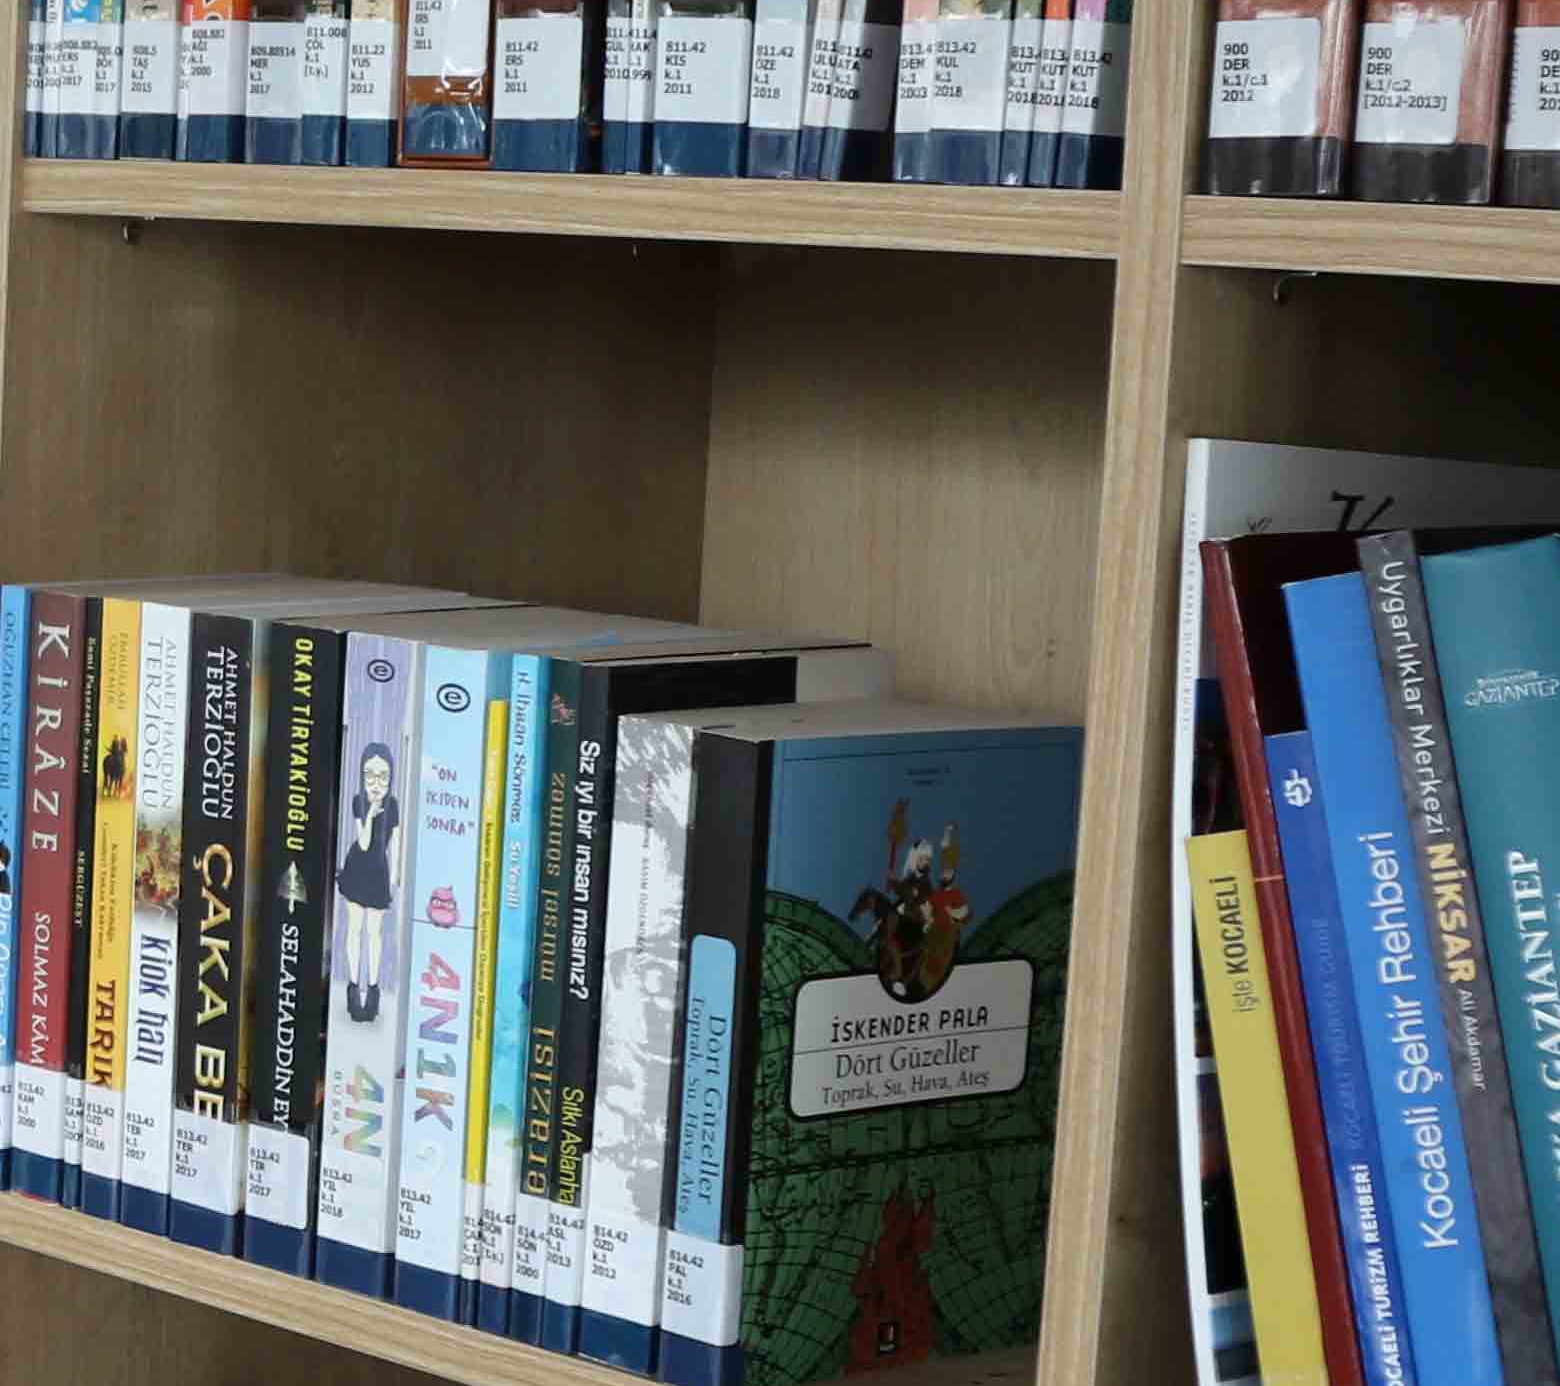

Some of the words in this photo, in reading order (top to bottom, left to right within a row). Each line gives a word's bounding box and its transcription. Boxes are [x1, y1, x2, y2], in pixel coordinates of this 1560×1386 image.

[506, 43, 539, 52] 811.42
[506, 56, 524, 66] ERS
[666, 42, 706, 54] 811.42
[666, 56, 686, 67] KIS
[937, 42, 976, 55] 813.42
[937, 56, 960, 68] KUL
[1223, 59, 1250, 71] DER
[1224, 43, 1248, 55] 900
[1366, 63, 1392, 75] DER
[1368, 47, 1392, 59] 900
[505, 82, 528, 93] 2011
[664, 84, 692, 94] 2011
[934, 86, 962, 98] 2018
[1222, 90, 1254, 102] 2012
[1381, 559, 1424, 716] Uygarlıklar
[294, 637, 314, 695] OKAY
[30, 619, 71, 854] KİRÂZE
[201, 645, 225, 820] TERZİOĞLU
[286, 703, 313, 851] TİRYAKİOĞLU
[1410, 722, 1452, 836] Merkezi
[1209, 875, 1249, 974] KOCAELİ
[1358, 829, 1419, 990] Rehberi
[1425, 841, 1477, 985] NİKSAR
[191, 844, 233, 1026] ÇAKA
[31, 911, 52, 1009] SOLMAZ
[278, 922, 301, 1092] SELAHADDİN
[831, 1010, 933, 1046] İSKENDER
[937, 1005, 990, 1032] PALA
[415, 953, 460, 1131] 4N1K
[706, 1015, 730, 1072] Dört
[834, 1046, 885, 1080] Dört
[889, 1039, 983, 1076] Güzeller
[1391, 993, 1434, 1095] Şehir
[821, 1083, 880, 1108] Toprak,
[884, 1080, 907, 1102] Su,
[910, 1074, 953, 1098] Hava,
[955, 1068, 991, 1092] Ateş
[696, 1078, 727, 1208] Güzeller
[1406, 1102, 1459, 1250] Kocaeli
